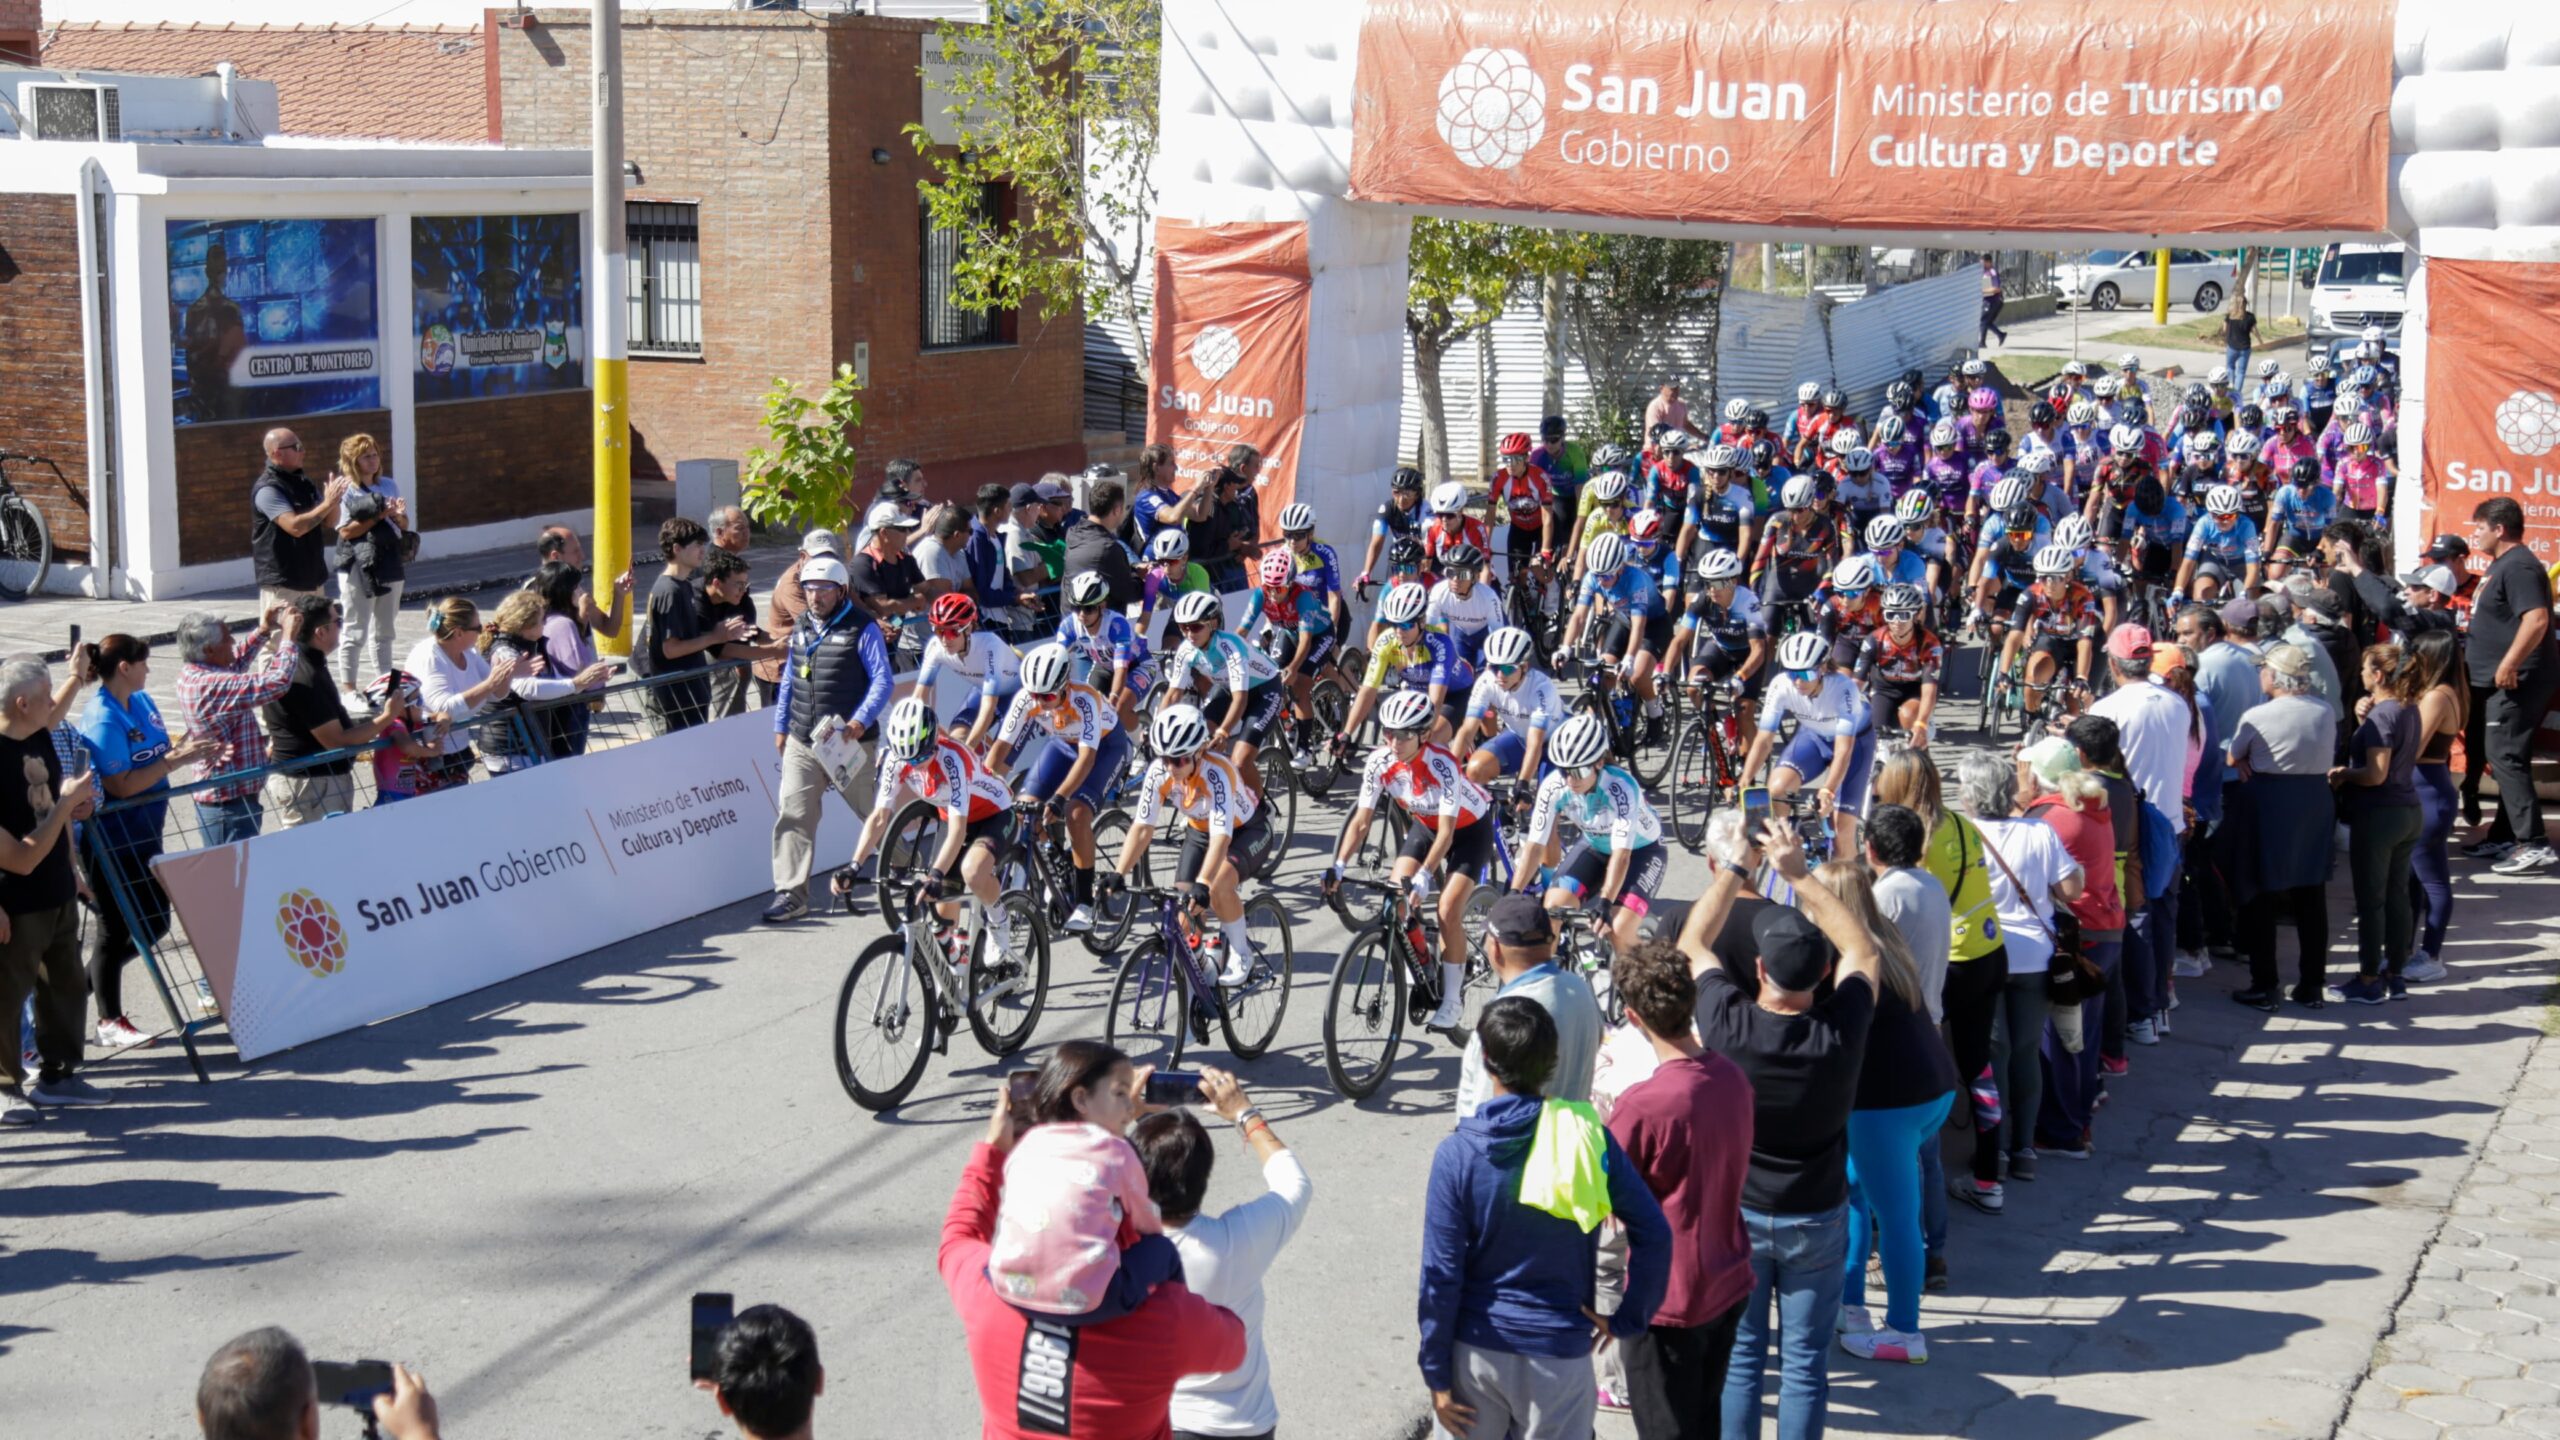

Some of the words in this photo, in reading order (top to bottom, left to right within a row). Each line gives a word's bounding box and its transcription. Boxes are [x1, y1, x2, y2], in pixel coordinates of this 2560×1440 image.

[1561, 63, 1659, 115] San
[1675, 70, 1807, 121] Juan
[1872, 82, 2053, 118] Ministerio
[2064, 81, 2110, 116] de
[2121, 78, 2284, 116] Turismo
[1560, 129, 1731, 174] Gobierno
[1868, 133, 2009, 169] Cultura
[2017, 142, 2042, 175] y
[2052, 135, 2220, 176] Deporte
[461, 332, 502, 354] Municipalidad
[503, 334, 512, 351] de
[512, 331, 541, 351] Sarmiento
[250, 354, 292, 377] CENTRO
[294, 353, 310, 374] DE
[311, 349, 372, 372] MONITOREO
[1161, 384, 1200, 412] San
[1208, 389, 1274, 418] Juan
[1184, 418, 1239, 435] Gobierno
[2446, 461, 2512, 492] San
[2528, 537, 2551, 552] de
[608, 792, 675, 831] Ministerio
[674, 789, 693, 811] de
[691, 776, 750, 804] Turismo,
[621, 828, 674, 857] Cultura
[674, 826, 684, 845] y
[685, 808, 738, 838] Deporte
[357, 896, 413, 932] San
[417, 873, 480, 915] Juan
[479, 841, 587, 892] Gobierno
